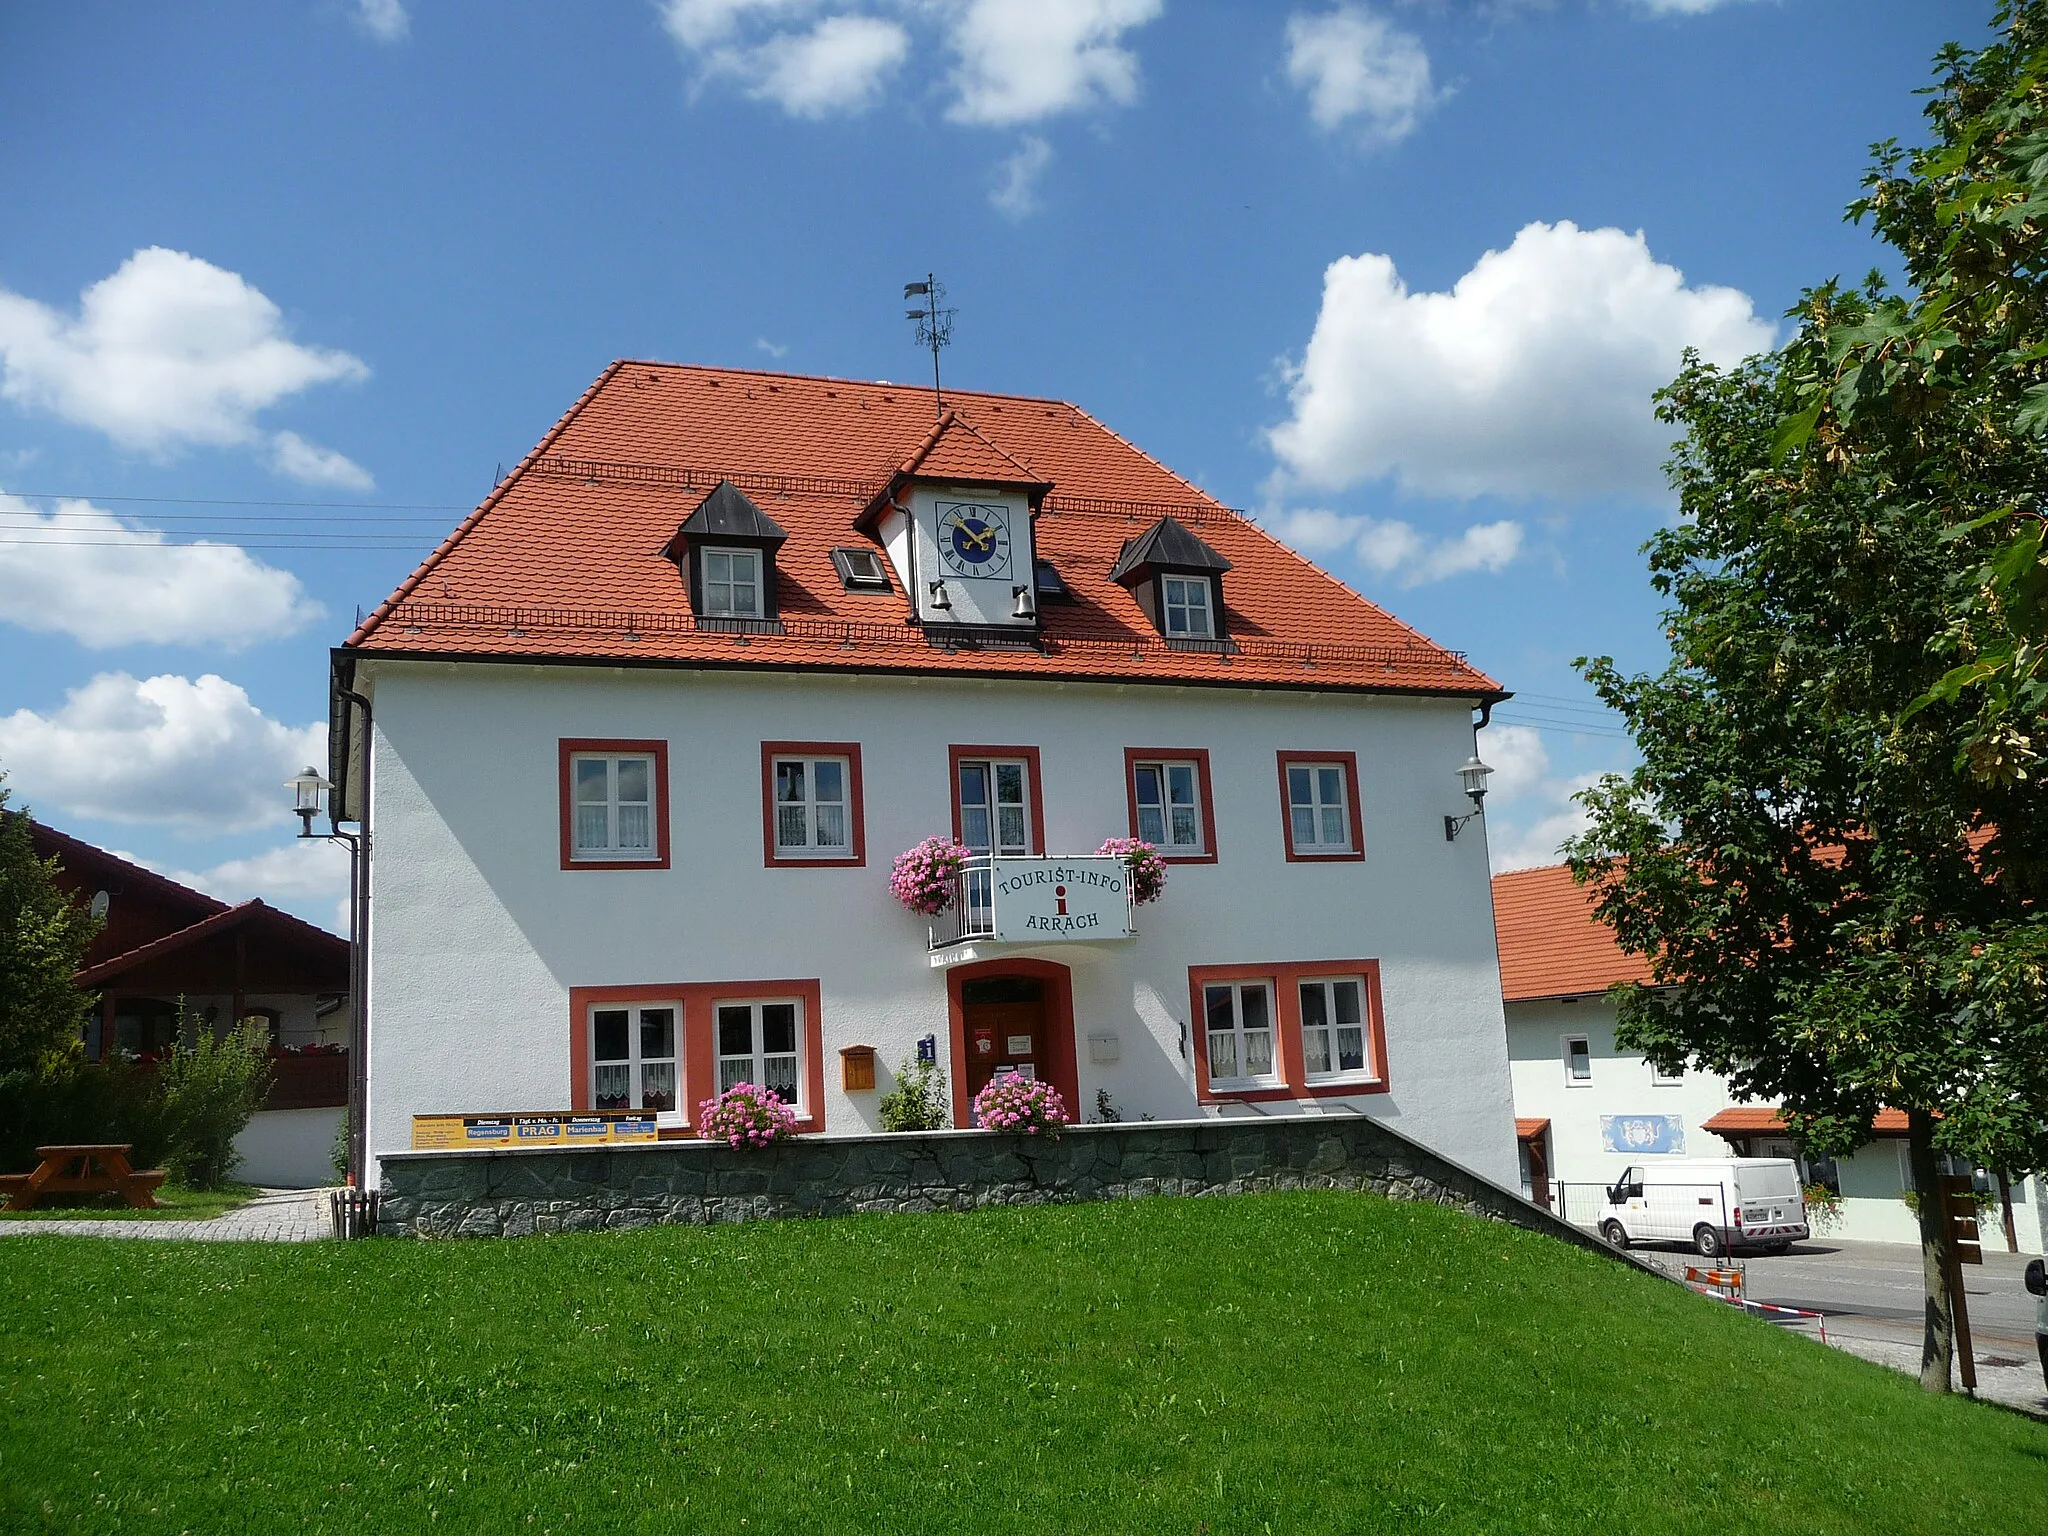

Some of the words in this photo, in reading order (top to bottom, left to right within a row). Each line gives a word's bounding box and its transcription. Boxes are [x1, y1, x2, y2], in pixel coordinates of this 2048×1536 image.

[998, 869, 1121, 896] TOURIST-INFO
[1026, 913, 1099, 931] ARRACH
[522, 1126, 555, 1136] PRAG
[568, 1125, 606, 1133] Marienbad
